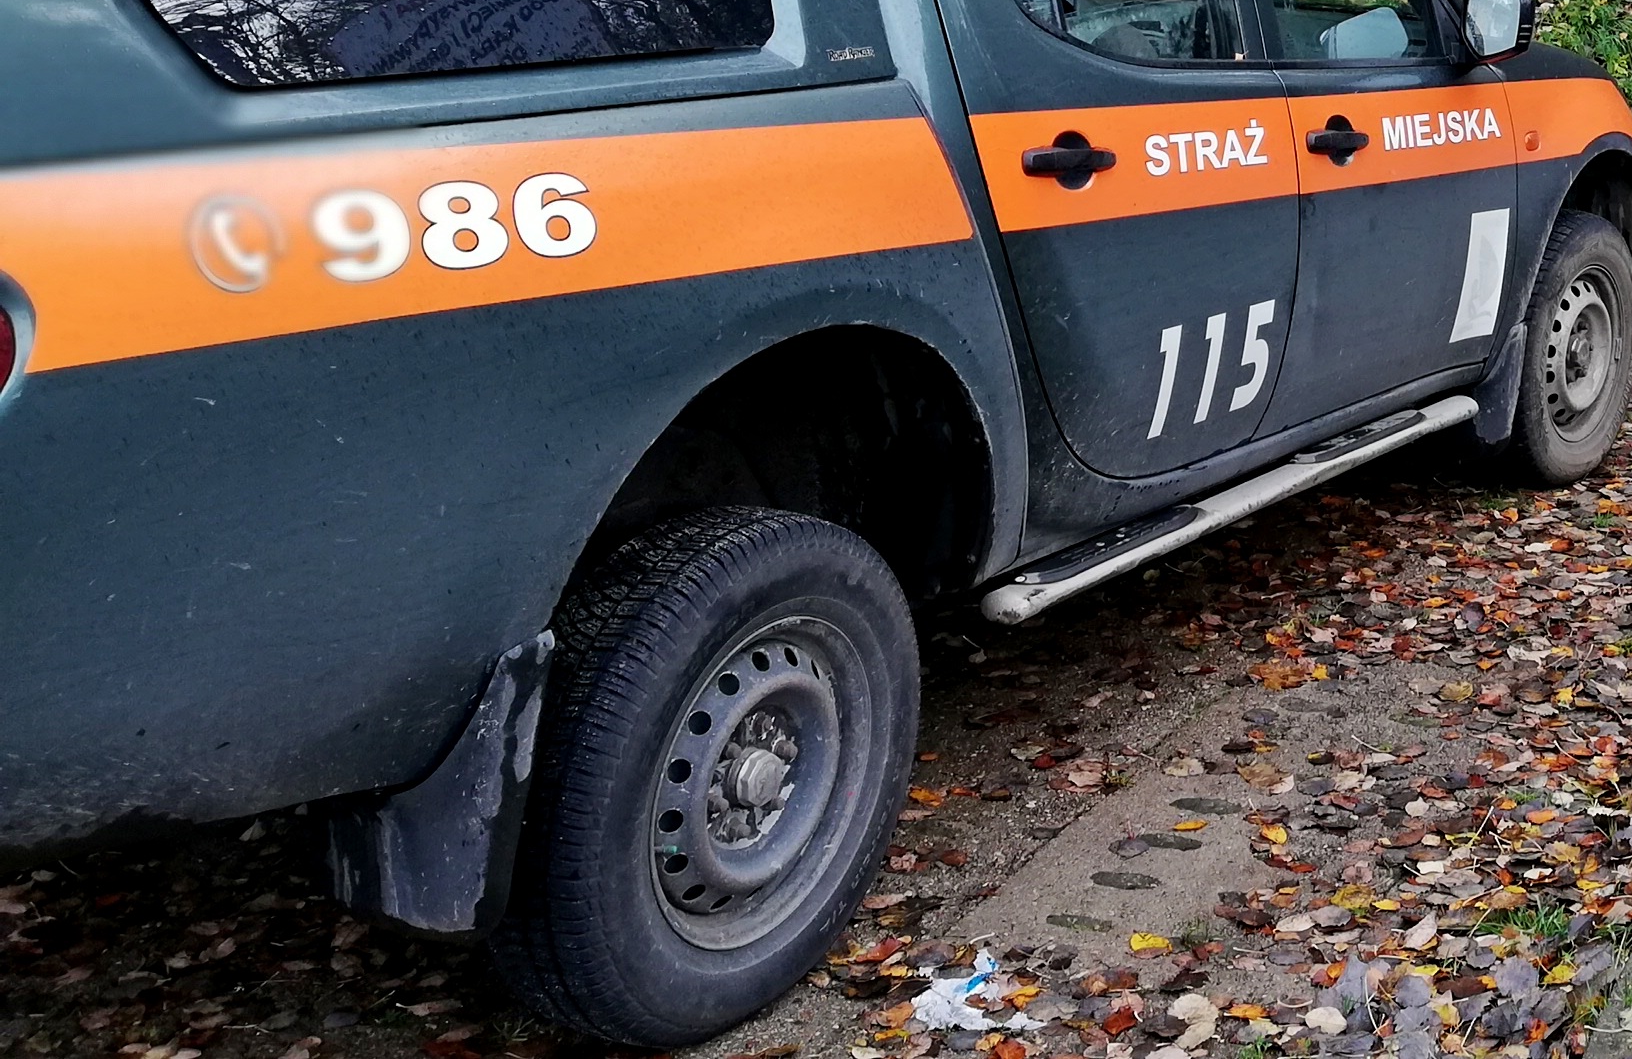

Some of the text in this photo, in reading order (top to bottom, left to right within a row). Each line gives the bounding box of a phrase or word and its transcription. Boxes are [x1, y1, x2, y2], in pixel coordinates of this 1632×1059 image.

[1144, 107, 1501, 177] STRAŻ MIEJSKA
[311, 173, 598, 283] 986
[1147, 299, 1275, 440] 115
